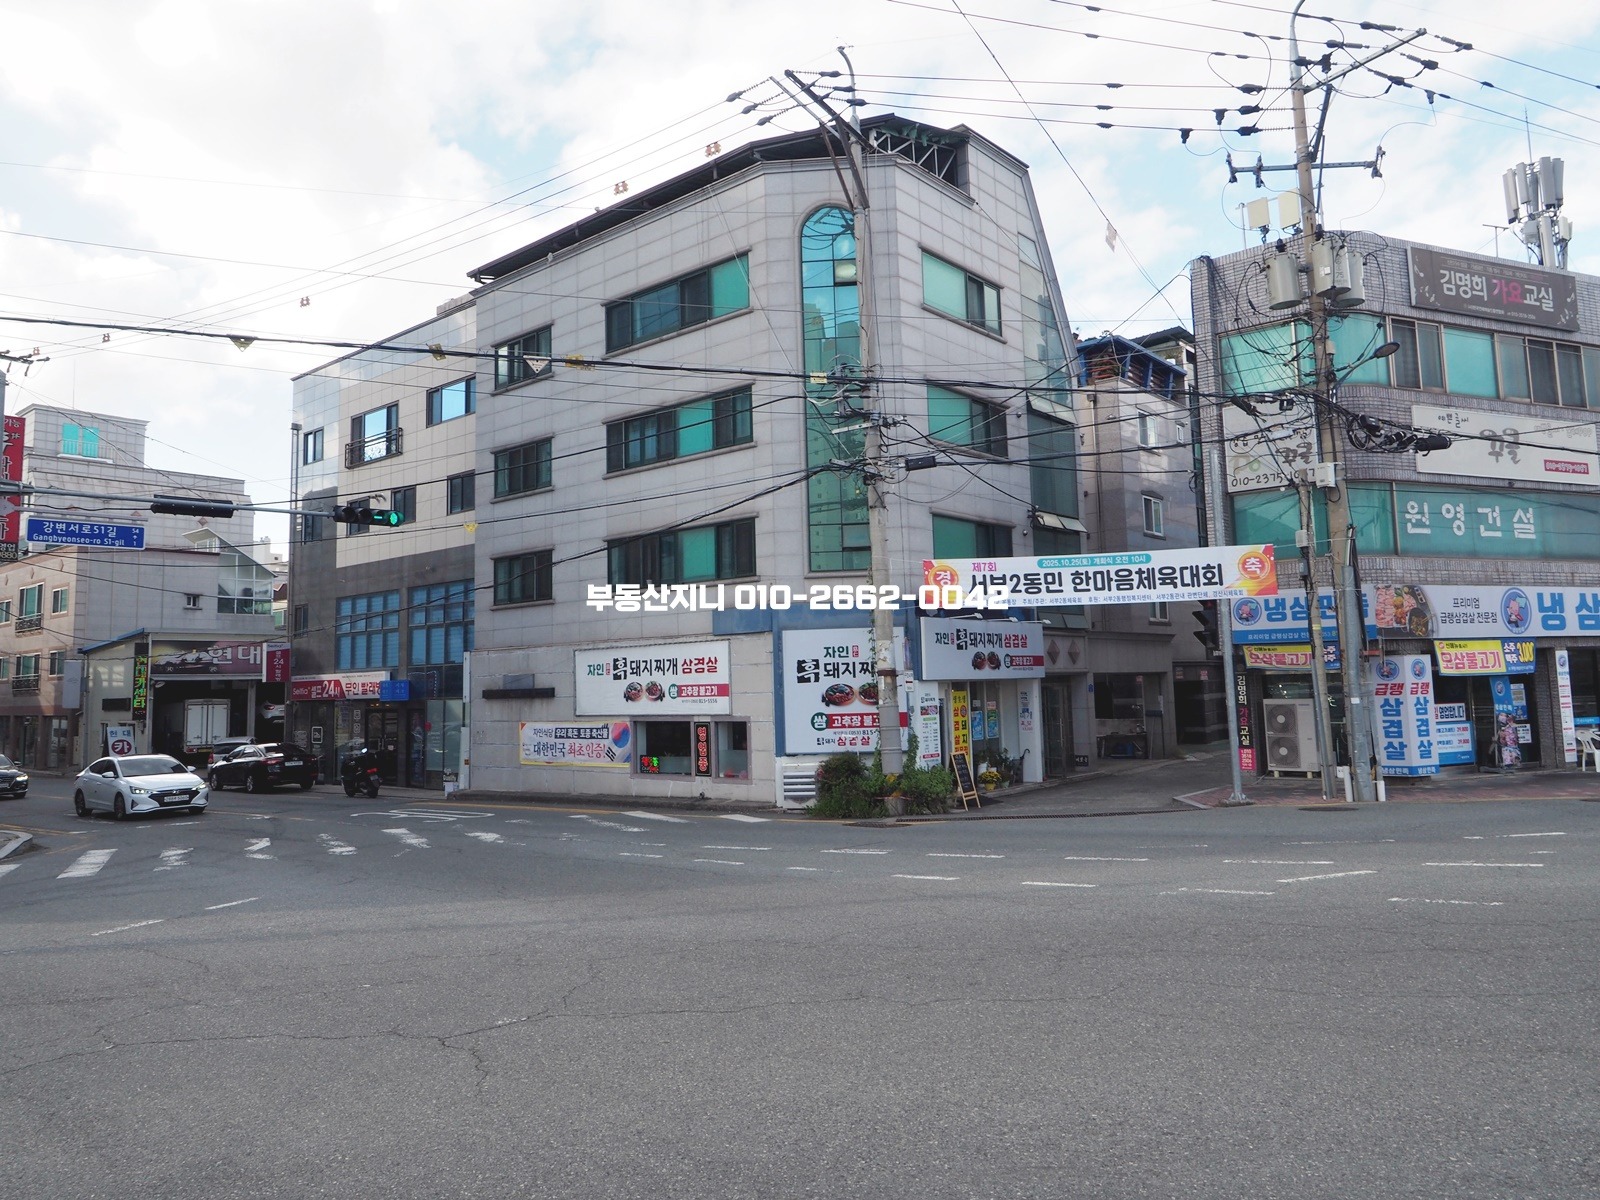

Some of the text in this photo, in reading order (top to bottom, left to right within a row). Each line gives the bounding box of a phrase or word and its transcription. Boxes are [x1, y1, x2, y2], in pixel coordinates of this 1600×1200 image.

[1439, 269, 1488, 301] 김명희
[1491, 279, 1555, 312] 가요교실
[1404, 500, 1537, 540] 원영건설
[43, 521, 117, 538] 강변서로51길
[33, 533, 125, 547] Gangbyeonseo-ro 51-gil
[1115, 556, 1129, 564] 오전
[1131, 555, 1146, 563] 10시
[1244, 557, 1261, 575] 축
[972, 562, 997, 573] 제7회
[1070, 563, 1224, 593] 한마음체육대회
[1453, 597, 1480, 609] 프리미엄
[1476, 611, 1498, 624] 전문점
[1536, 592, 1600, 631] 냉삼
[934, 632, 950, 645] 자인
[207, 645, 262, 665] 현대
[823, 646, 849, 658] 자인
[1440, 651, 1502, 670] 오삼불고기
[587, 663, 605, 676] 자인
[796, 658, 876, 684] 흑돼지찌
[345, 682, 360, 696] 무인
[1237, 675, 1247, 706] 김명희
[1374, 682, 1405, 696] 급랭
[1409, 682, 1431, 696] 급랭
[832, 715, 861, 727] 고추장
[1379, 697, 1408, 760] 삼겹살
[1413, 696, 1434, 760] 삼겹살
[114, 741, 129, 753] 카
[533, 741, 566, 758] 대한민국
